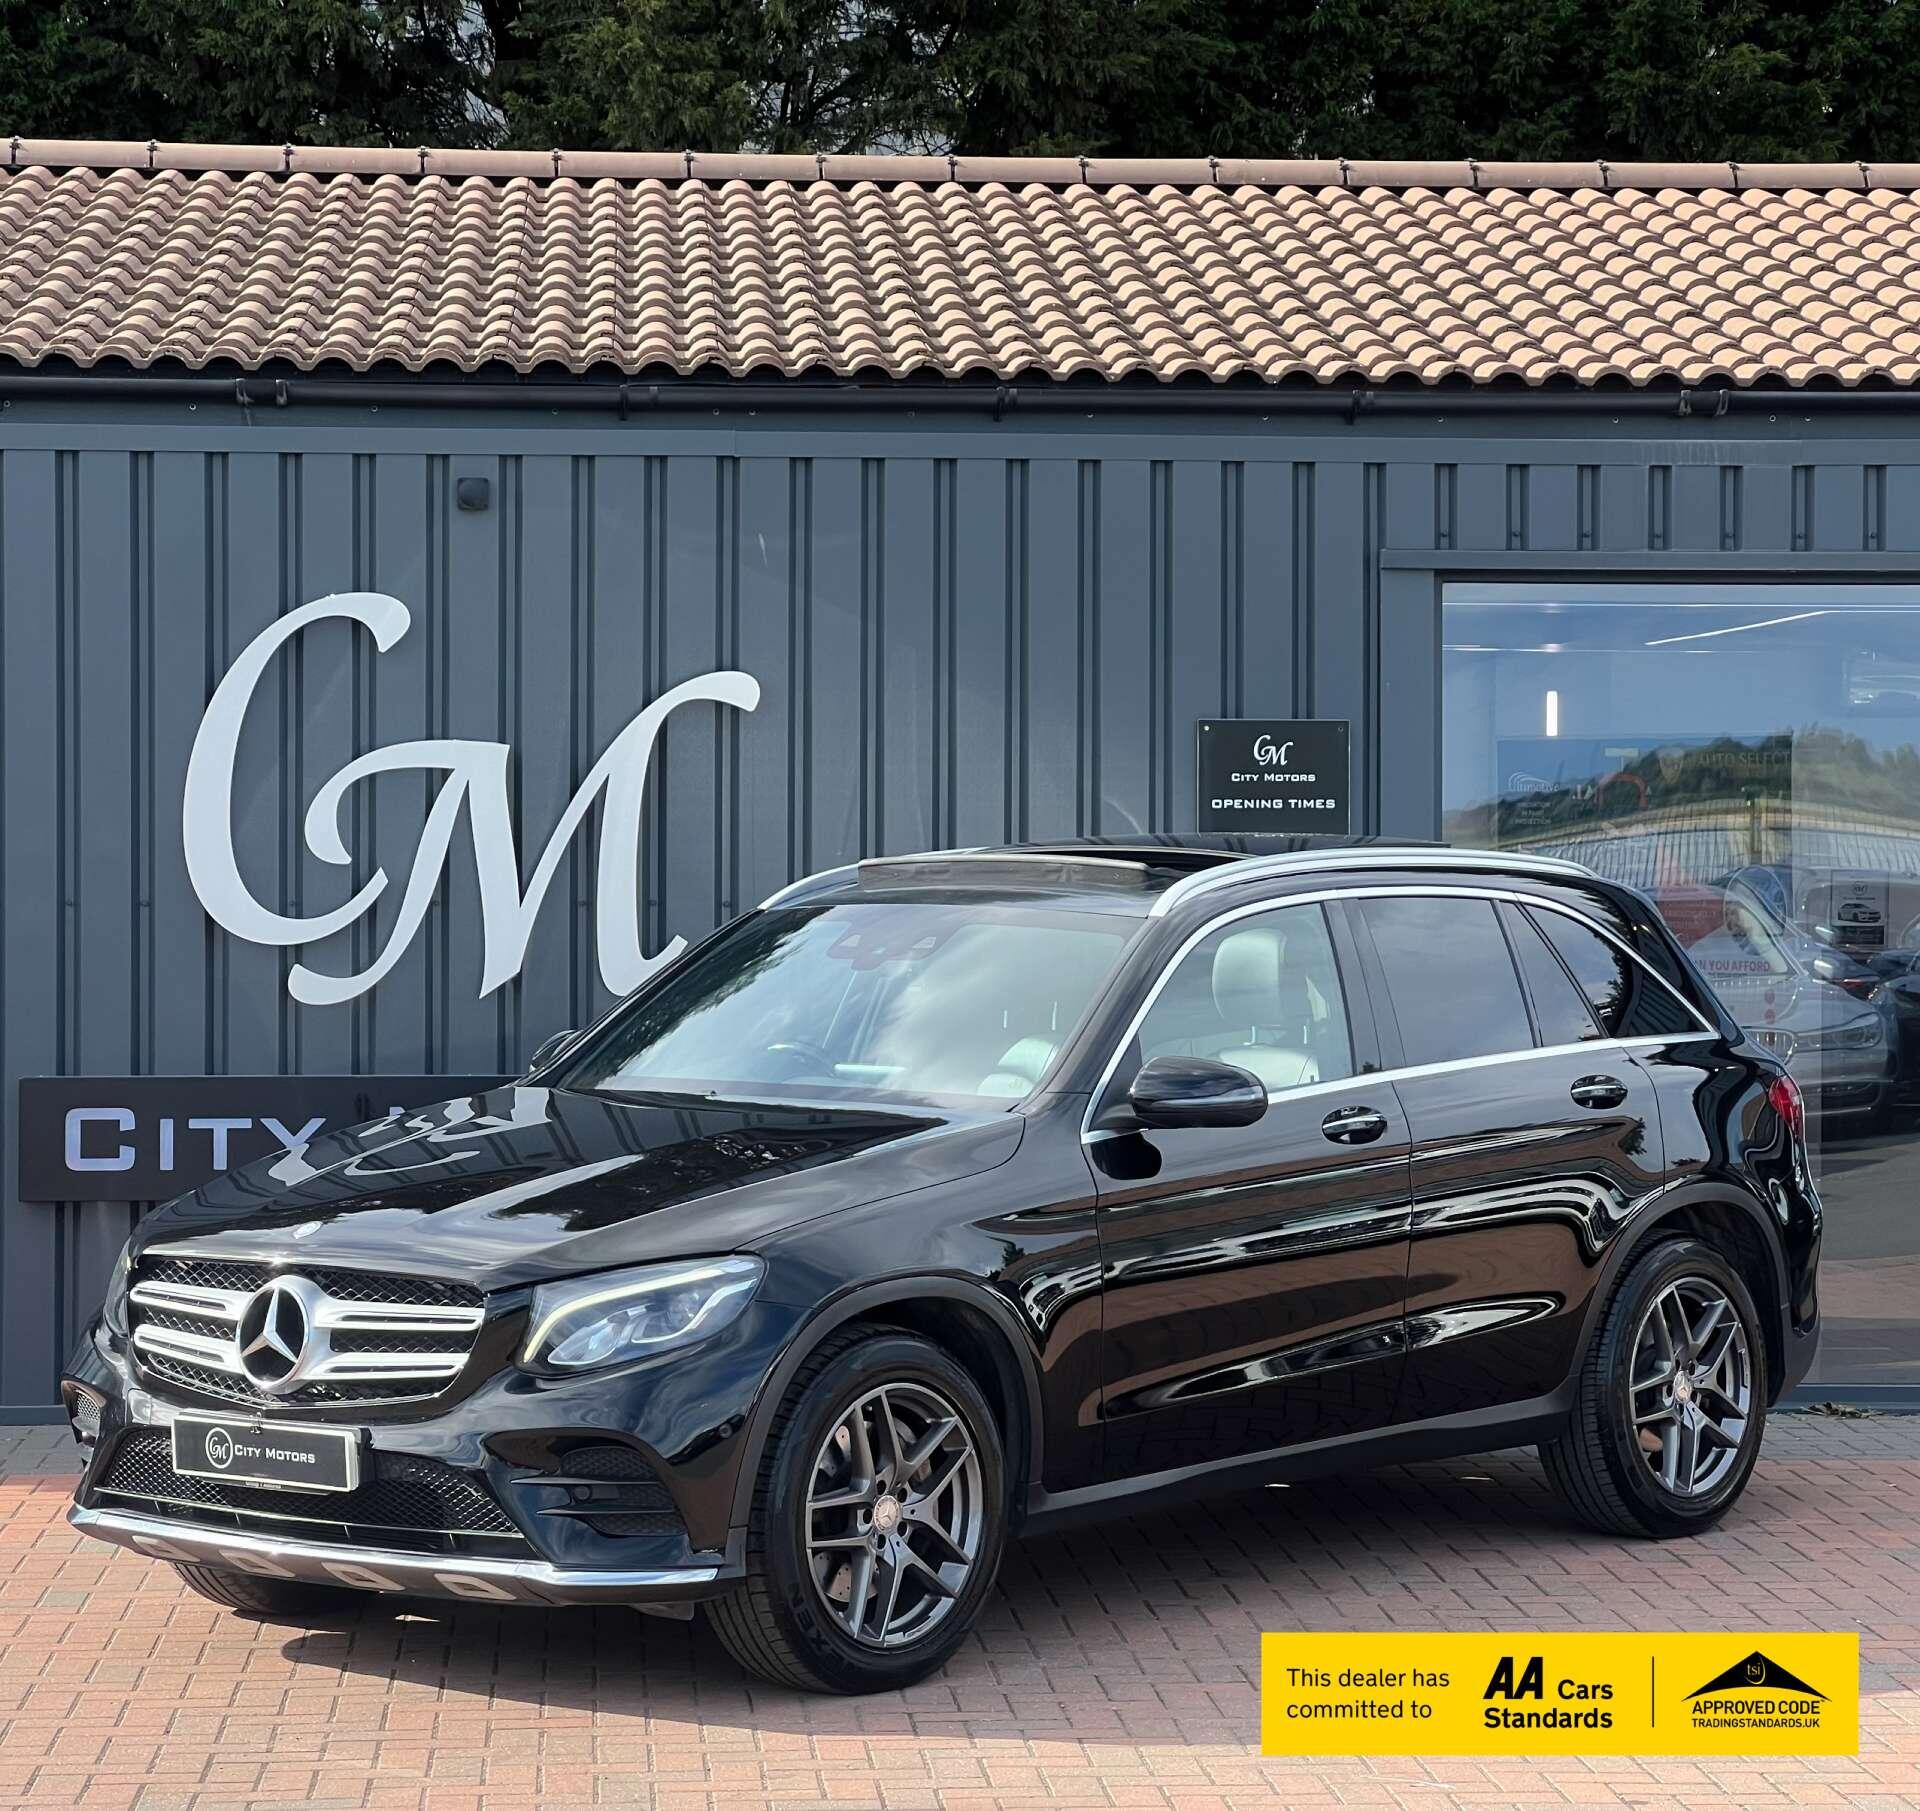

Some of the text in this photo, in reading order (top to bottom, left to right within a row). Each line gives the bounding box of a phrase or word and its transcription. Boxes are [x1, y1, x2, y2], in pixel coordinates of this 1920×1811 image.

[1231, 773, 1316, 782] CITY MOTORS
[1211, 799, 1336, 809] OPENING TIMES
[234, 1444, 261, 1458] CITY
[265, 1447, 316, 1464] MOTORS
